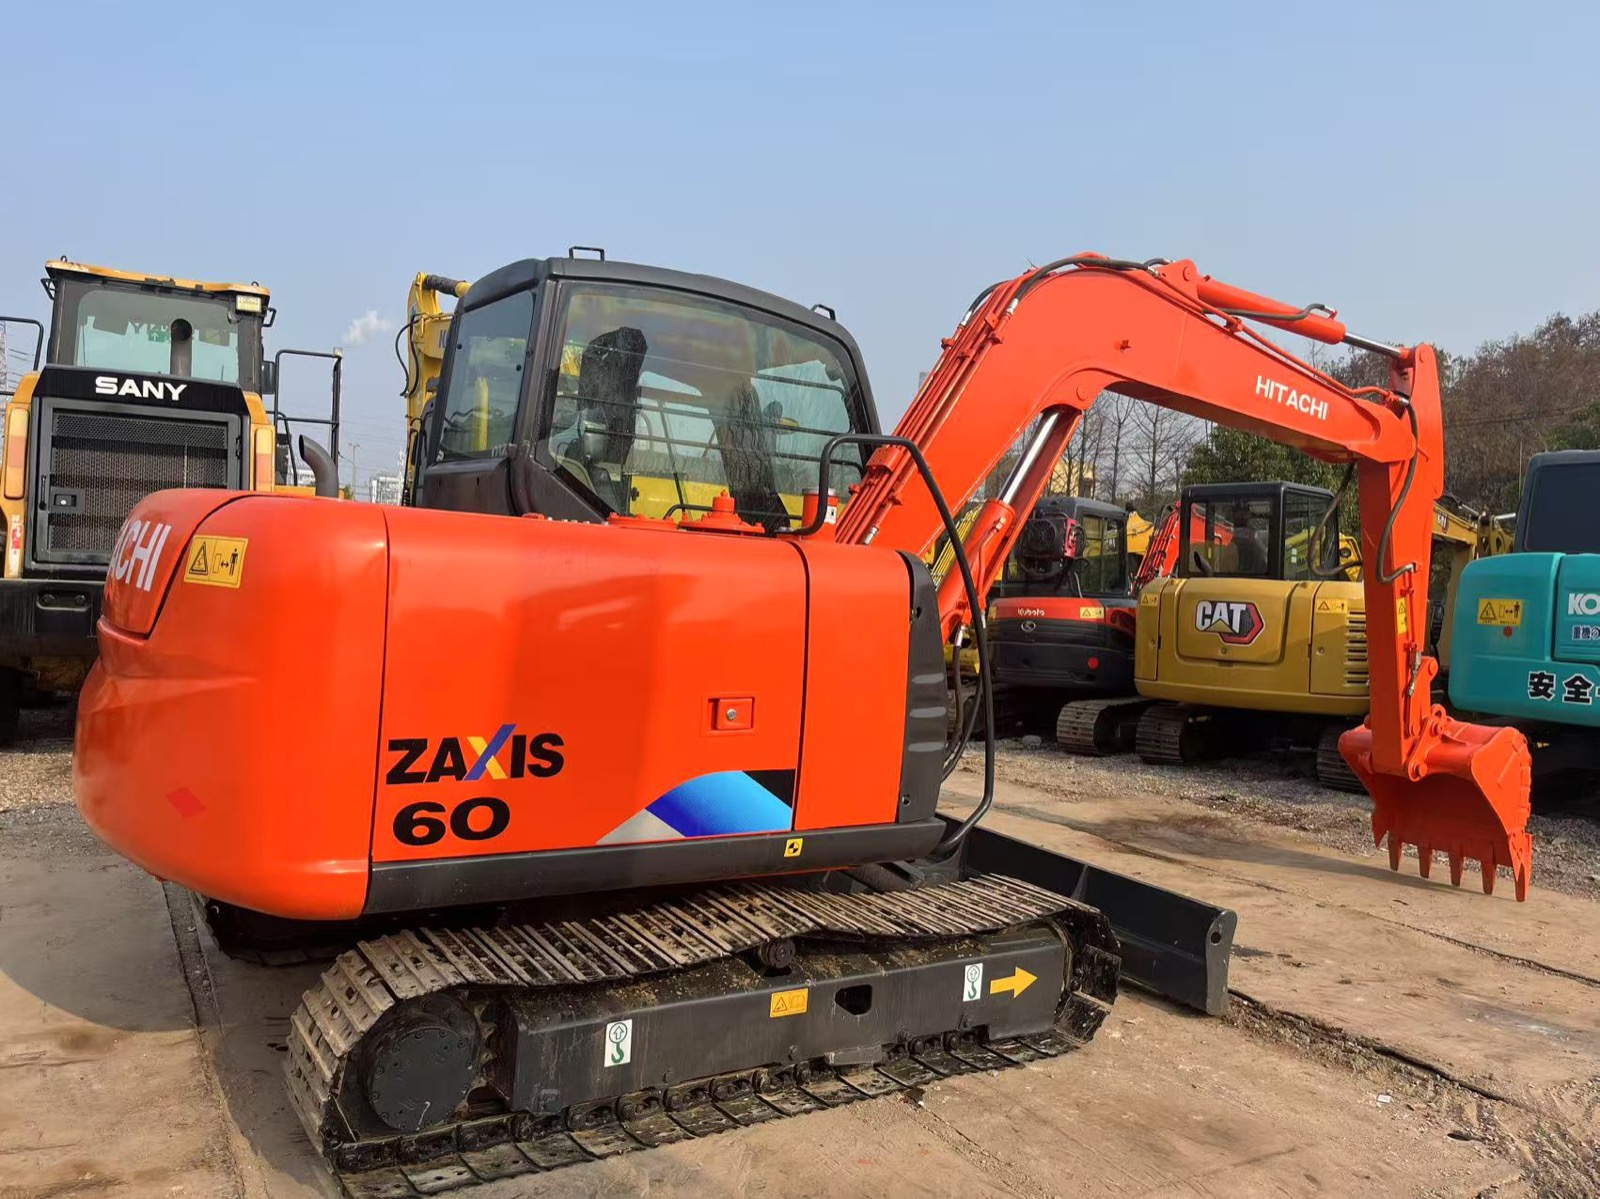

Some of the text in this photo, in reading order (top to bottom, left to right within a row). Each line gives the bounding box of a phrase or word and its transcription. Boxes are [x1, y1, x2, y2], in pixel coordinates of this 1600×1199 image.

[95, 376, 187, 401] SANY
[1255, 375, 1329, 420] HITACHI
[1196, 600, 1247, 634] CAT
[1528, 670, 1600, 705] 安全
[386, 723, 565, 785] ZAXIS
[392, 796, 511, 846] 60
